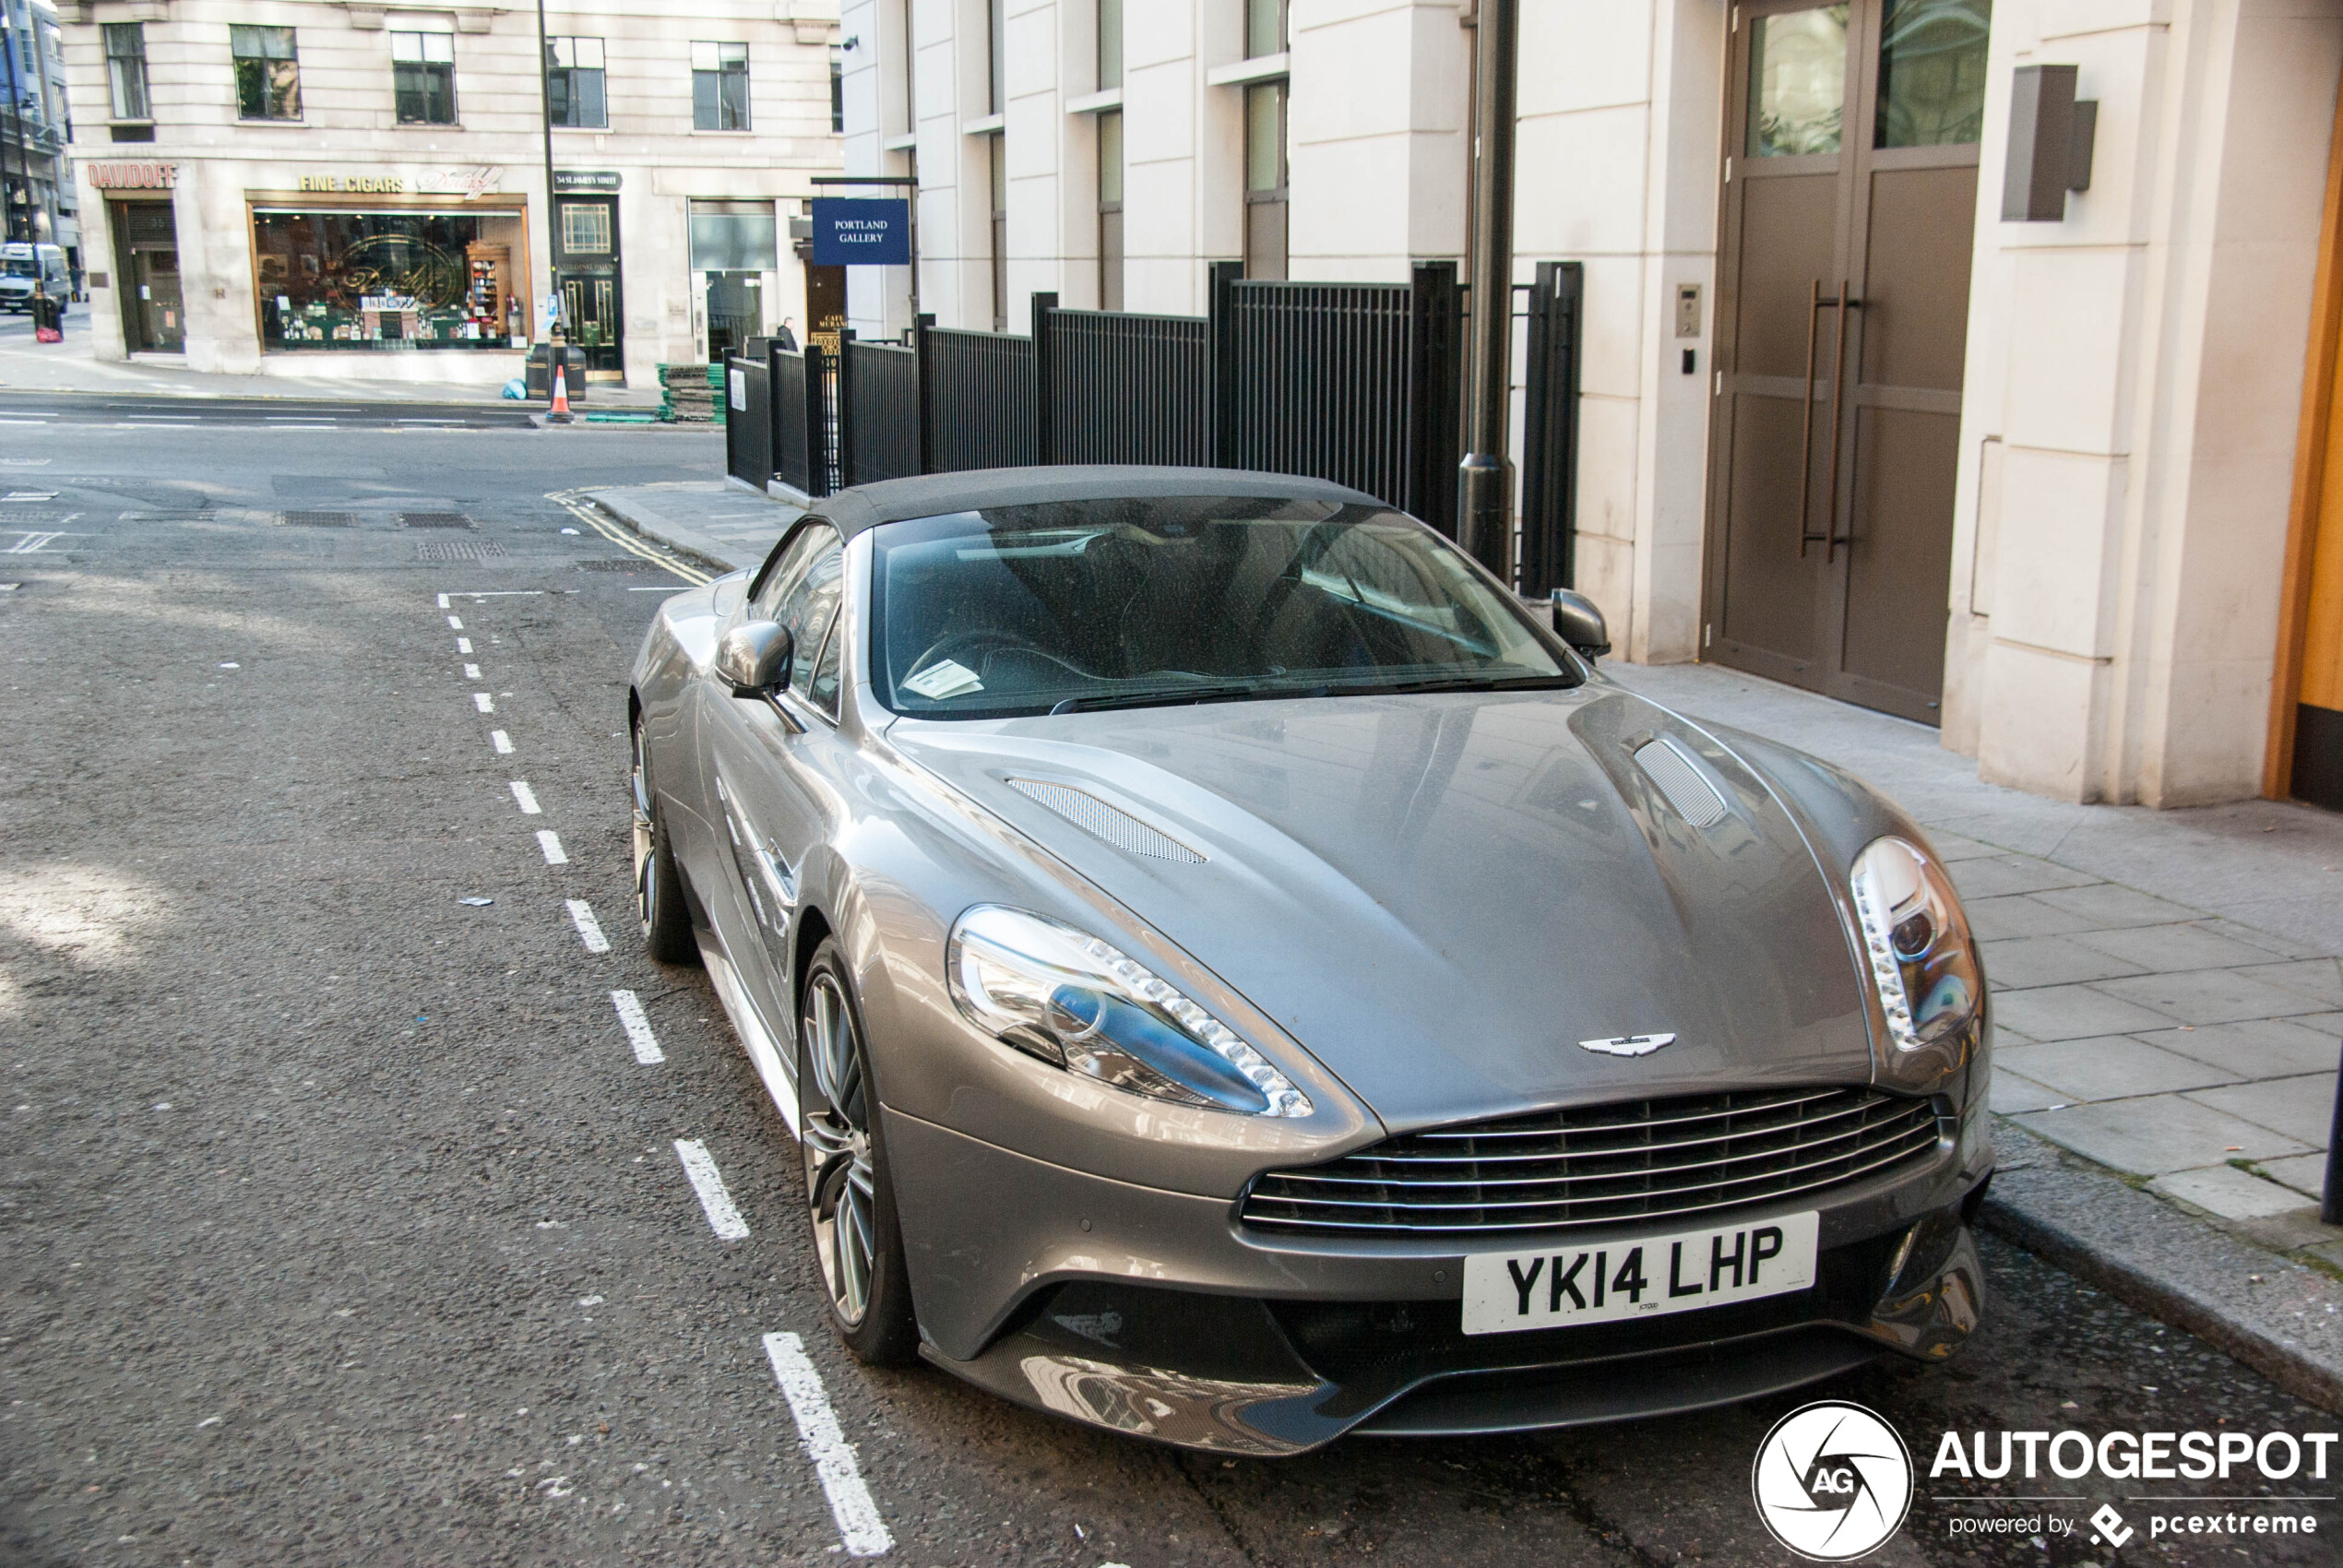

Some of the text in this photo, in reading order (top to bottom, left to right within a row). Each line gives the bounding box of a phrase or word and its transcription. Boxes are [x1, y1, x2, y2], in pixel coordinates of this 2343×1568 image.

[88, 164, 178, 188] DAVIDOFF
[300, 175, 405, 193] FINE CIGARS
[835, 220, 887, 230] PORTLAND
[839, 233, 883, 243] GALLERY
[1507, 1226, 1783, 1315] YK14 LHP
